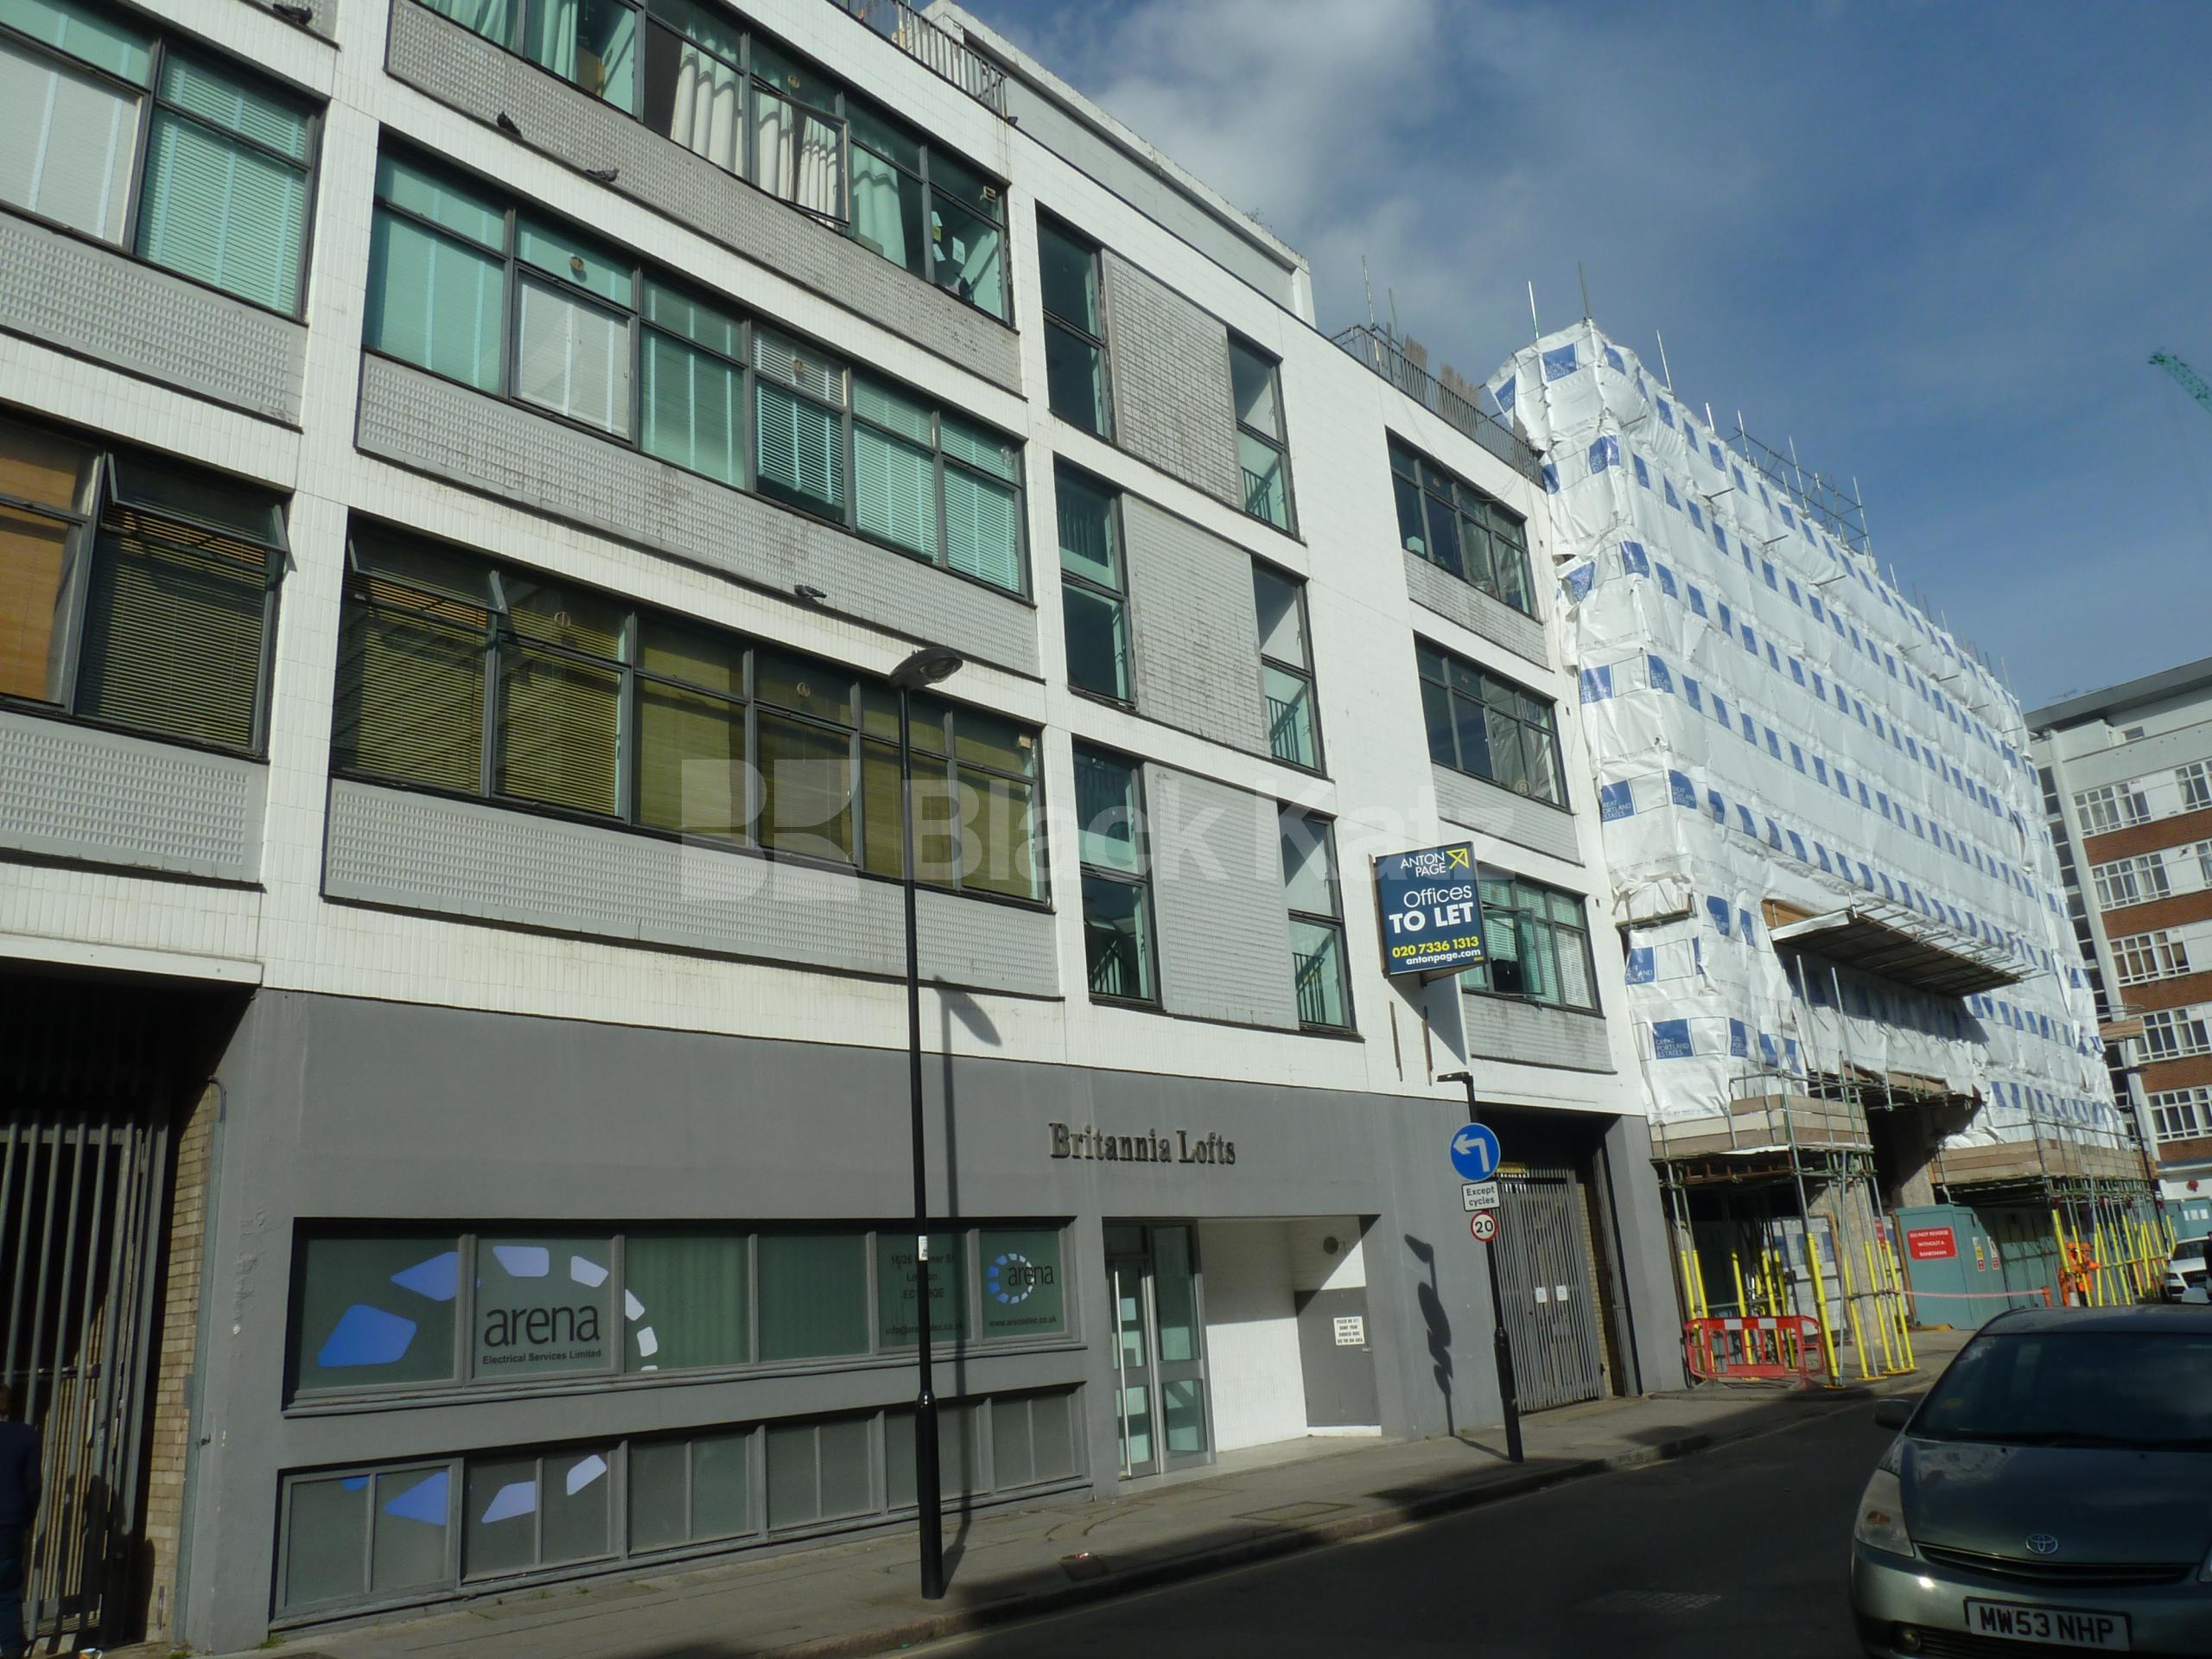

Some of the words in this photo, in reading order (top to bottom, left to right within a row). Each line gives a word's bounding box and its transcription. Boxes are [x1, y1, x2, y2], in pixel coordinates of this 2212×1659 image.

[1602, 802, 1631, 814] ORTLAND
[1401, 852, 1445, 869] ANTON
[1415, 862, 1446, 877] PAGE
[1403, 885, 1472, 908] Offices
[1389, 910, 1426, 933] TO
[1434, 901, 1474, 927] LET
[1392, 944, 1416, 957] 020
[1418, 940, 1450, 954] 7336
[1452, 936, 1479, 949] 1313
[1406, 949, 1481, 965] antonpage.com
[1048, 1122, 1173, 1163] Britannia
[1176, 1129, 1236, 1165] Lofts
[1466, 1185, 1496, 1197] Except
[1469, 1196, 1495, 1207] cycles
[1475, 1220, 1493, 1233] 20
[1008, 1265, 1053, 1287] arena
[484, 1305, 601, 1348] arena
[483, 1353, 525, 1364] Electrical
[529, 1351, 567, 1362] Services
[569, 1349, 601, 1359] Limited
[1980, 1605, 2050, 1638] MW53
[2056, 1614, 2114, 1643] NHP
